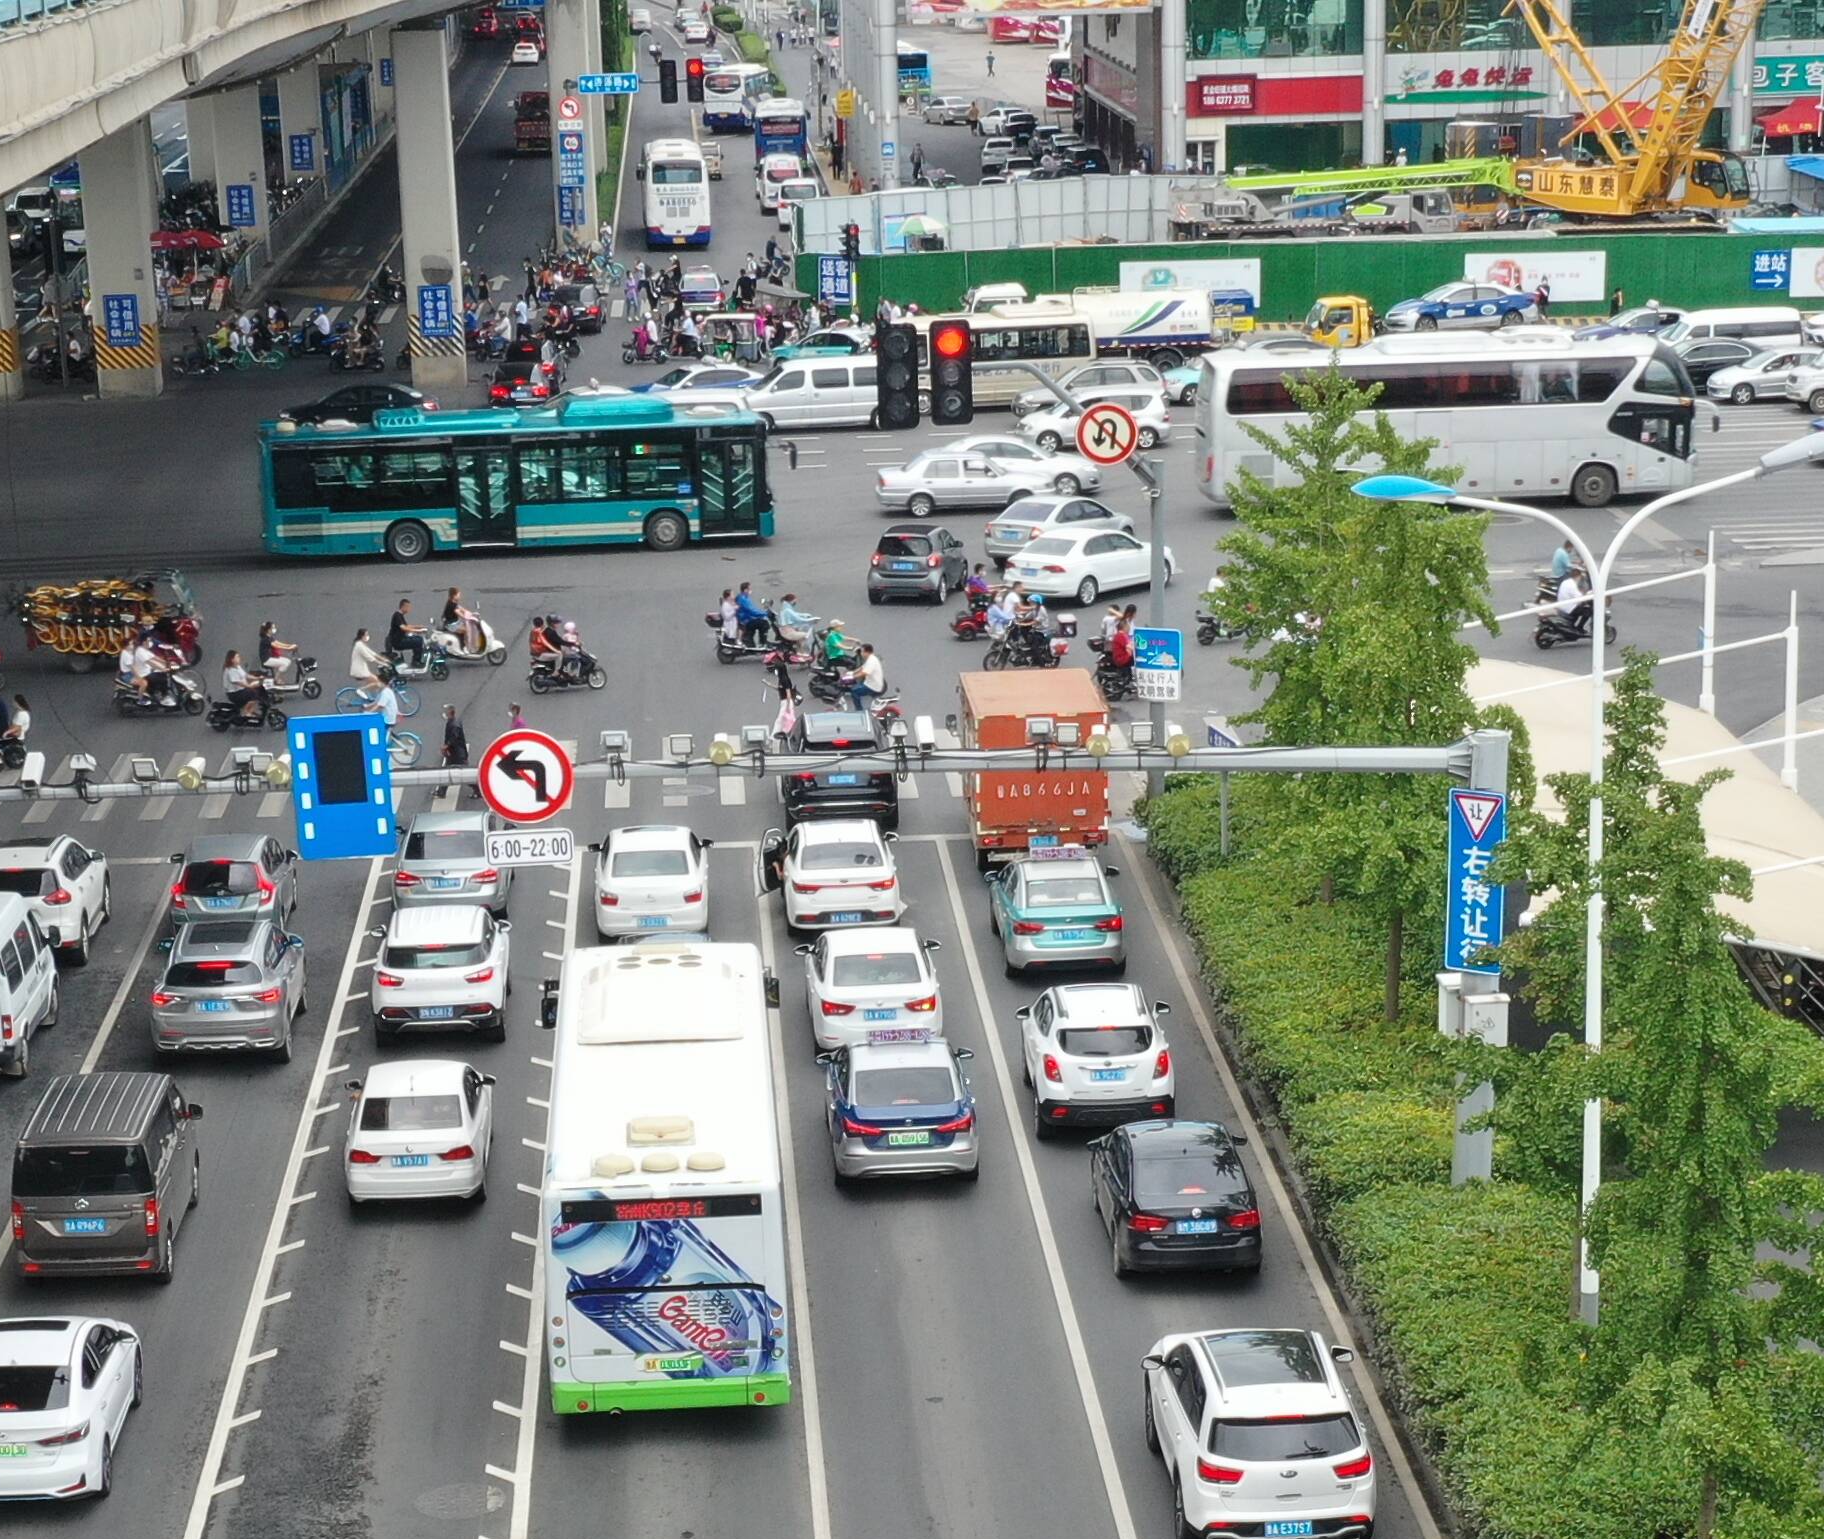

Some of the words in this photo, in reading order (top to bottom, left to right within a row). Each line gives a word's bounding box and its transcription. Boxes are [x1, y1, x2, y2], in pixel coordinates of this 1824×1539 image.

[821, 259, 849, 276] 送客
[1754, 253, 1788, 273] 进站
[821, 277, 849, 294] 通道
[1469, 802, 1483, 821] 让
[490, 837, 570, 860] 6:00-22:00
